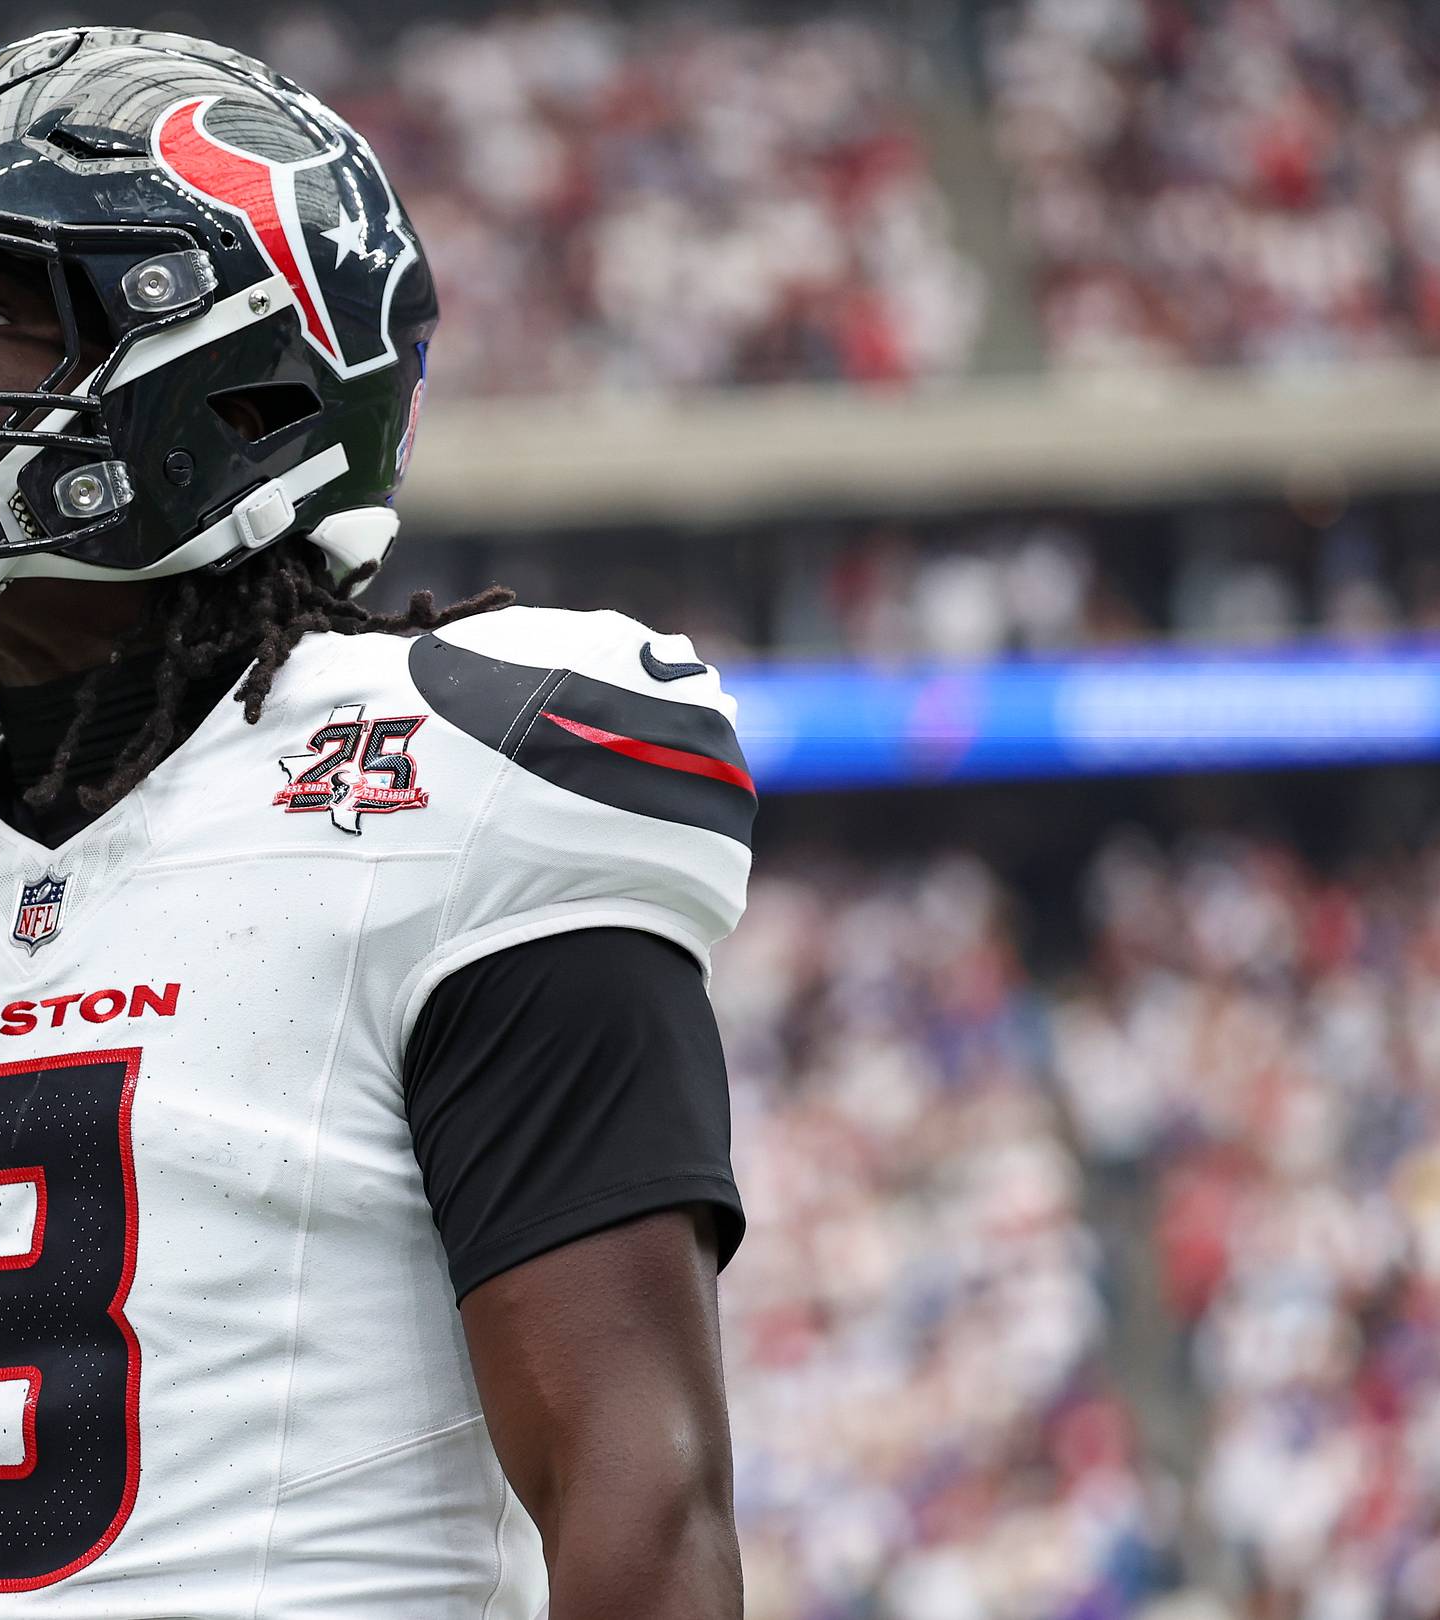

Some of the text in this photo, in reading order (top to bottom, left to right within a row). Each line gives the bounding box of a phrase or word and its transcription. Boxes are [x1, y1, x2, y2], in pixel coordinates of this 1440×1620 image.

[284, 714, 429, 814] 25
[304, 782, 328, 792] 2002
[376, 789, 416, 800] SEASONS
[17, 905, 53, 938] NFL
